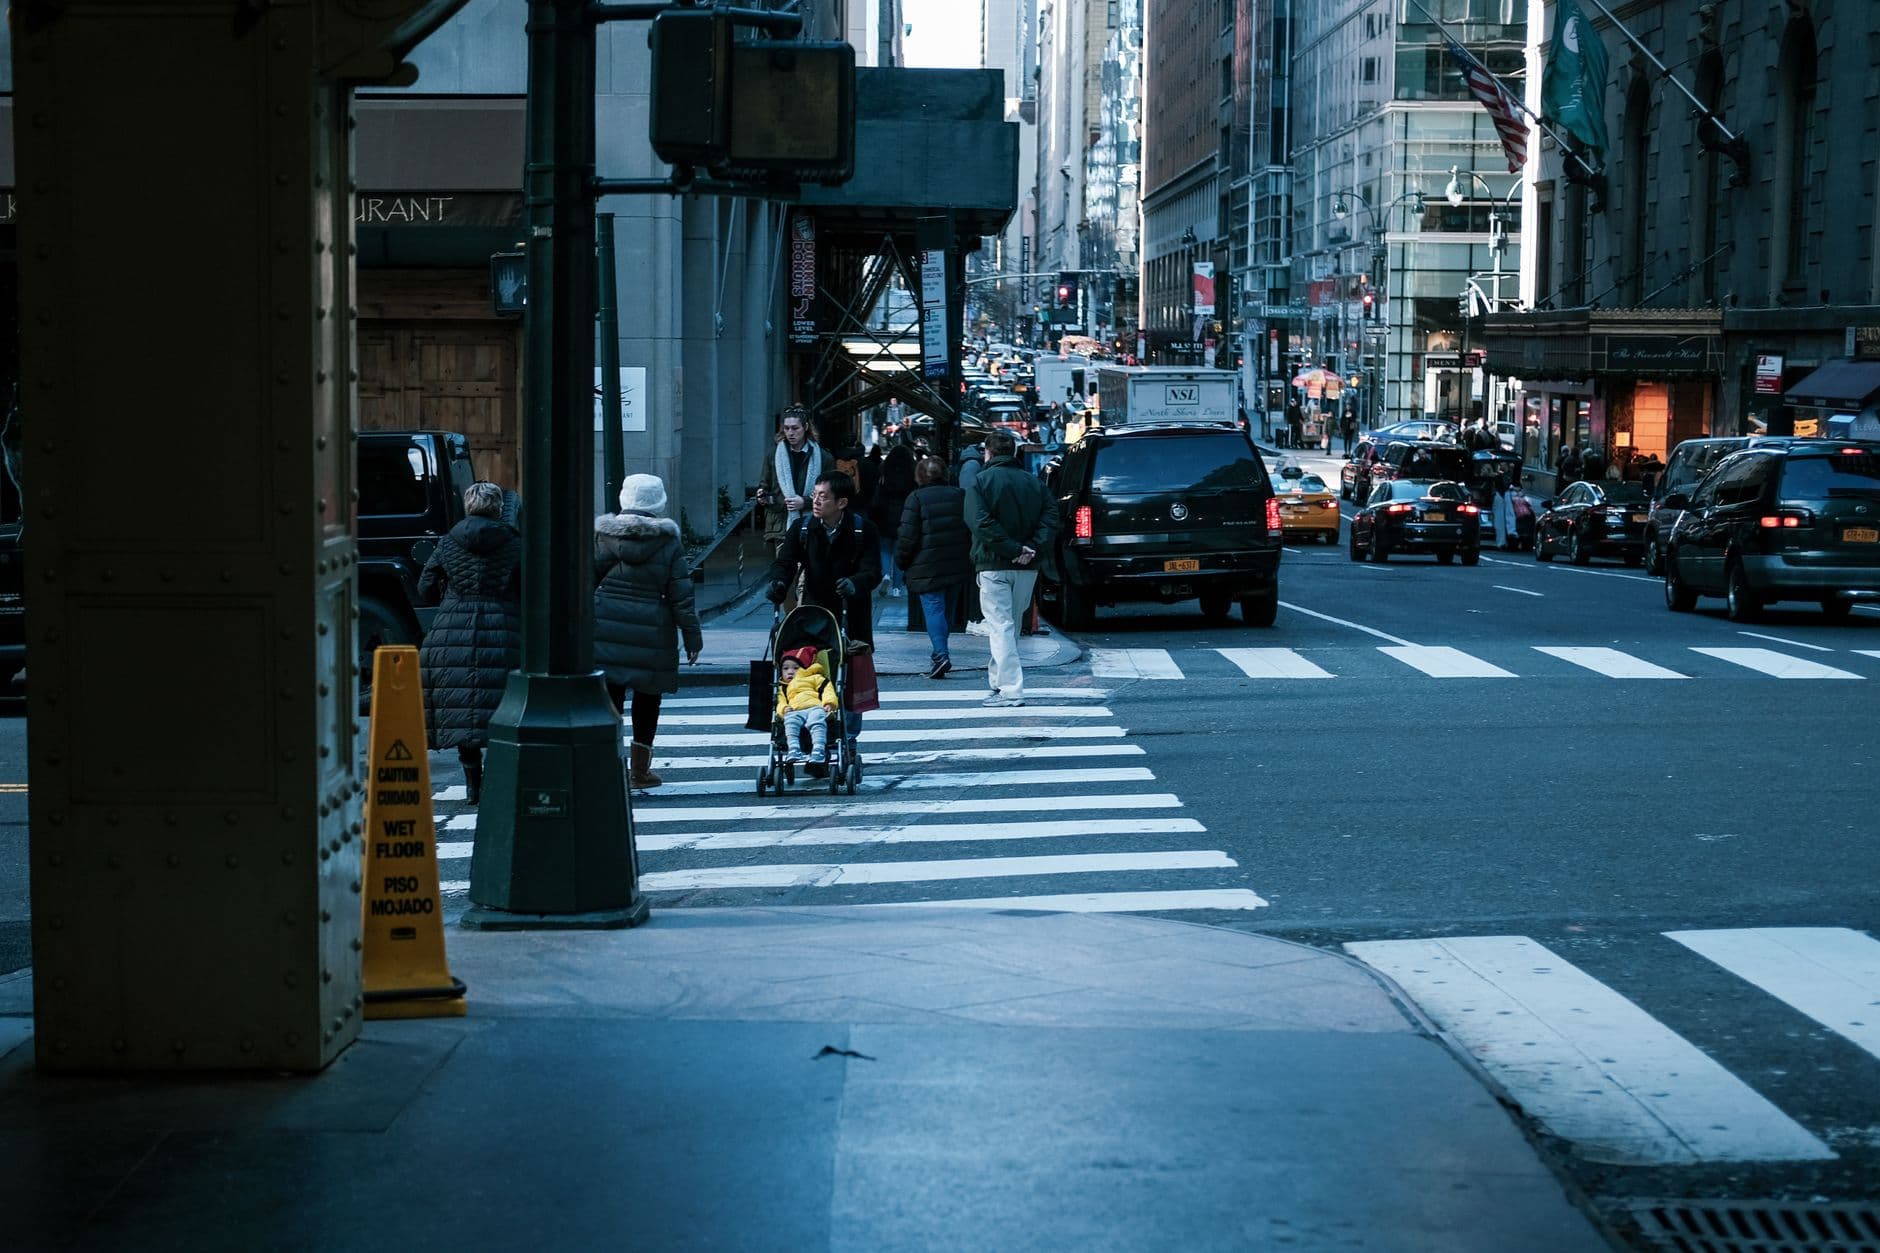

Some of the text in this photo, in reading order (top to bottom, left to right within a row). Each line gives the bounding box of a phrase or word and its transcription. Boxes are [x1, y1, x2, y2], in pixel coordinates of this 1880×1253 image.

[1168, 389, 1197, 401] NSL
[378, 767, 419, 783] CAUTION
[377, 790, 420, 806] CUIDADO
[383, 820, 416, 837] WET
[376, 842, 425, 859] FLOOR
[384, 876, 418, 894] PISO
[371, 898, 433, 916] MOJADO
